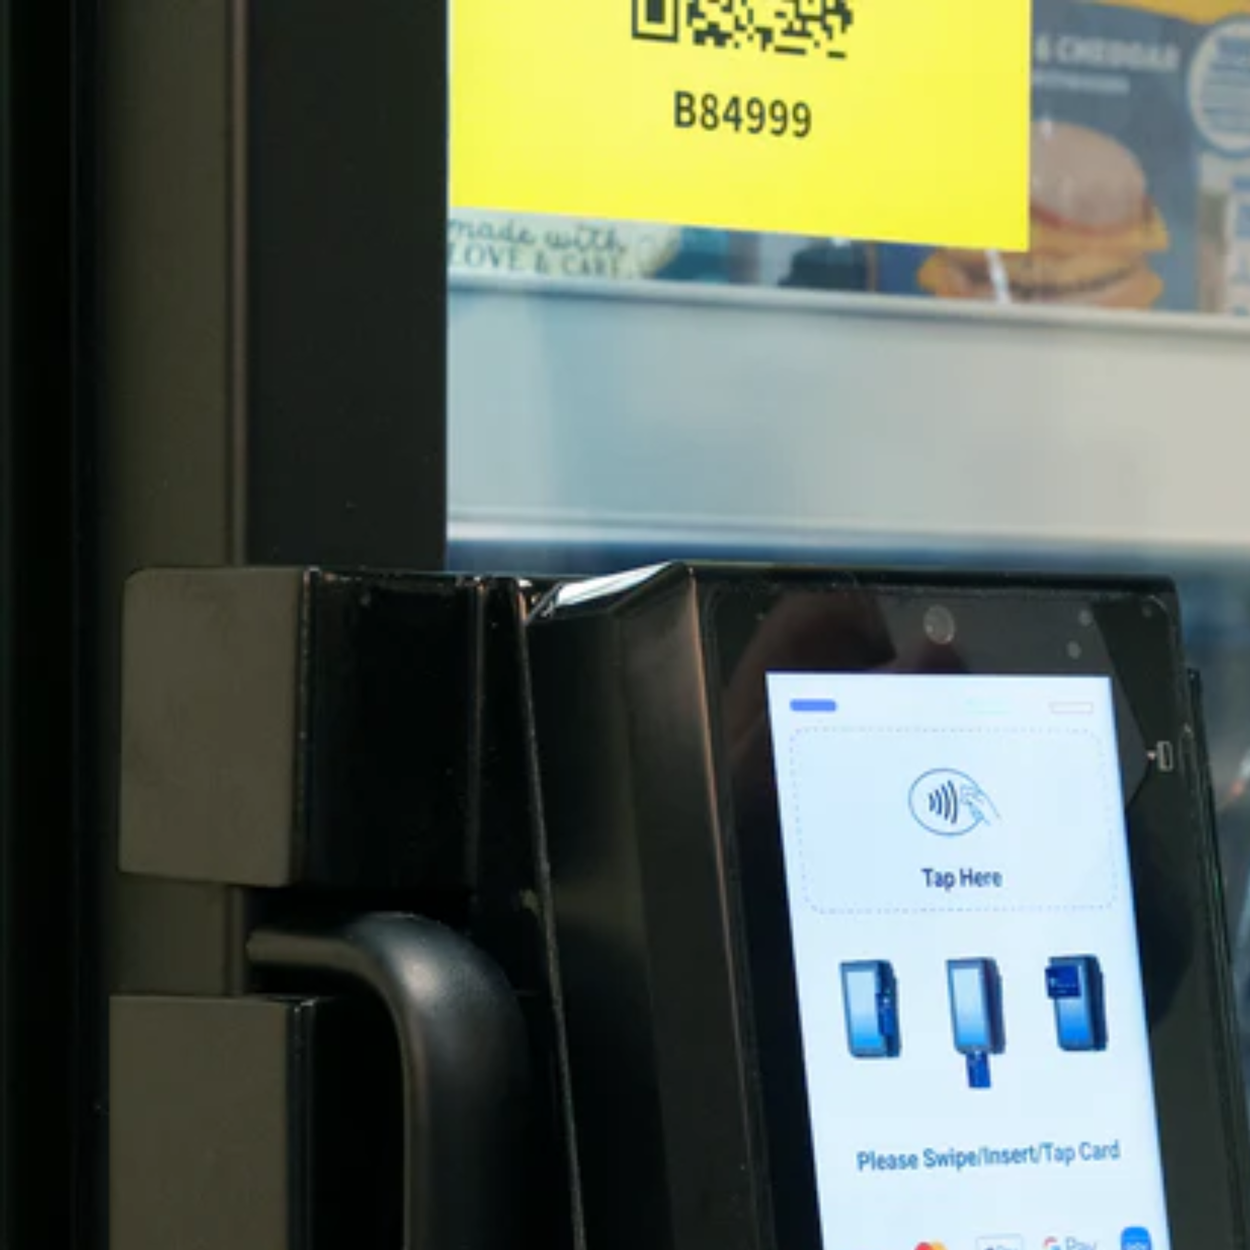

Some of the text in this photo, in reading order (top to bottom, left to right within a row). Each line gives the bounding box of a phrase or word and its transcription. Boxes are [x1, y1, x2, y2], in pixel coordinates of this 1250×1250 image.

[674, 89, 812, 138] B84999
[921, 867, 1003, 893] Tap Here
[856, 1138, 1122, 1173] Please Swipe/Insert/Tap Card
